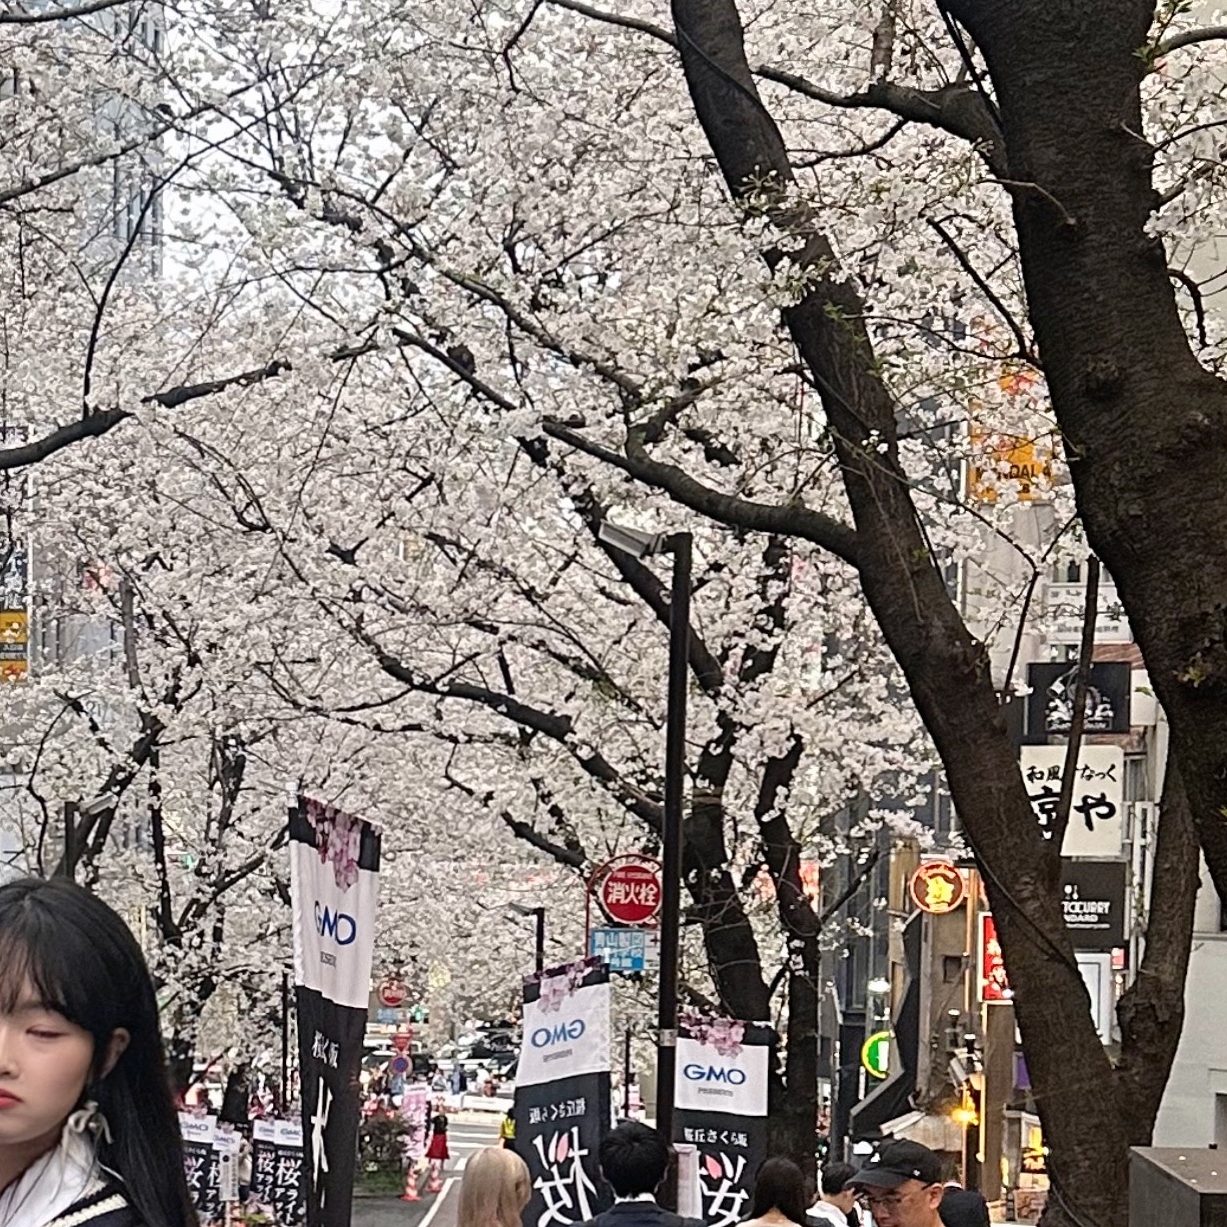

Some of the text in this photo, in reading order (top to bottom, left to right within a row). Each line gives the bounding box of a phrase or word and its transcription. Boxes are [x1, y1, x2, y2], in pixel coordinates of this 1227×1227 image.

[607, 882, 658, 906] 消火栓
[684, 1064, 746, 1085] GMO
